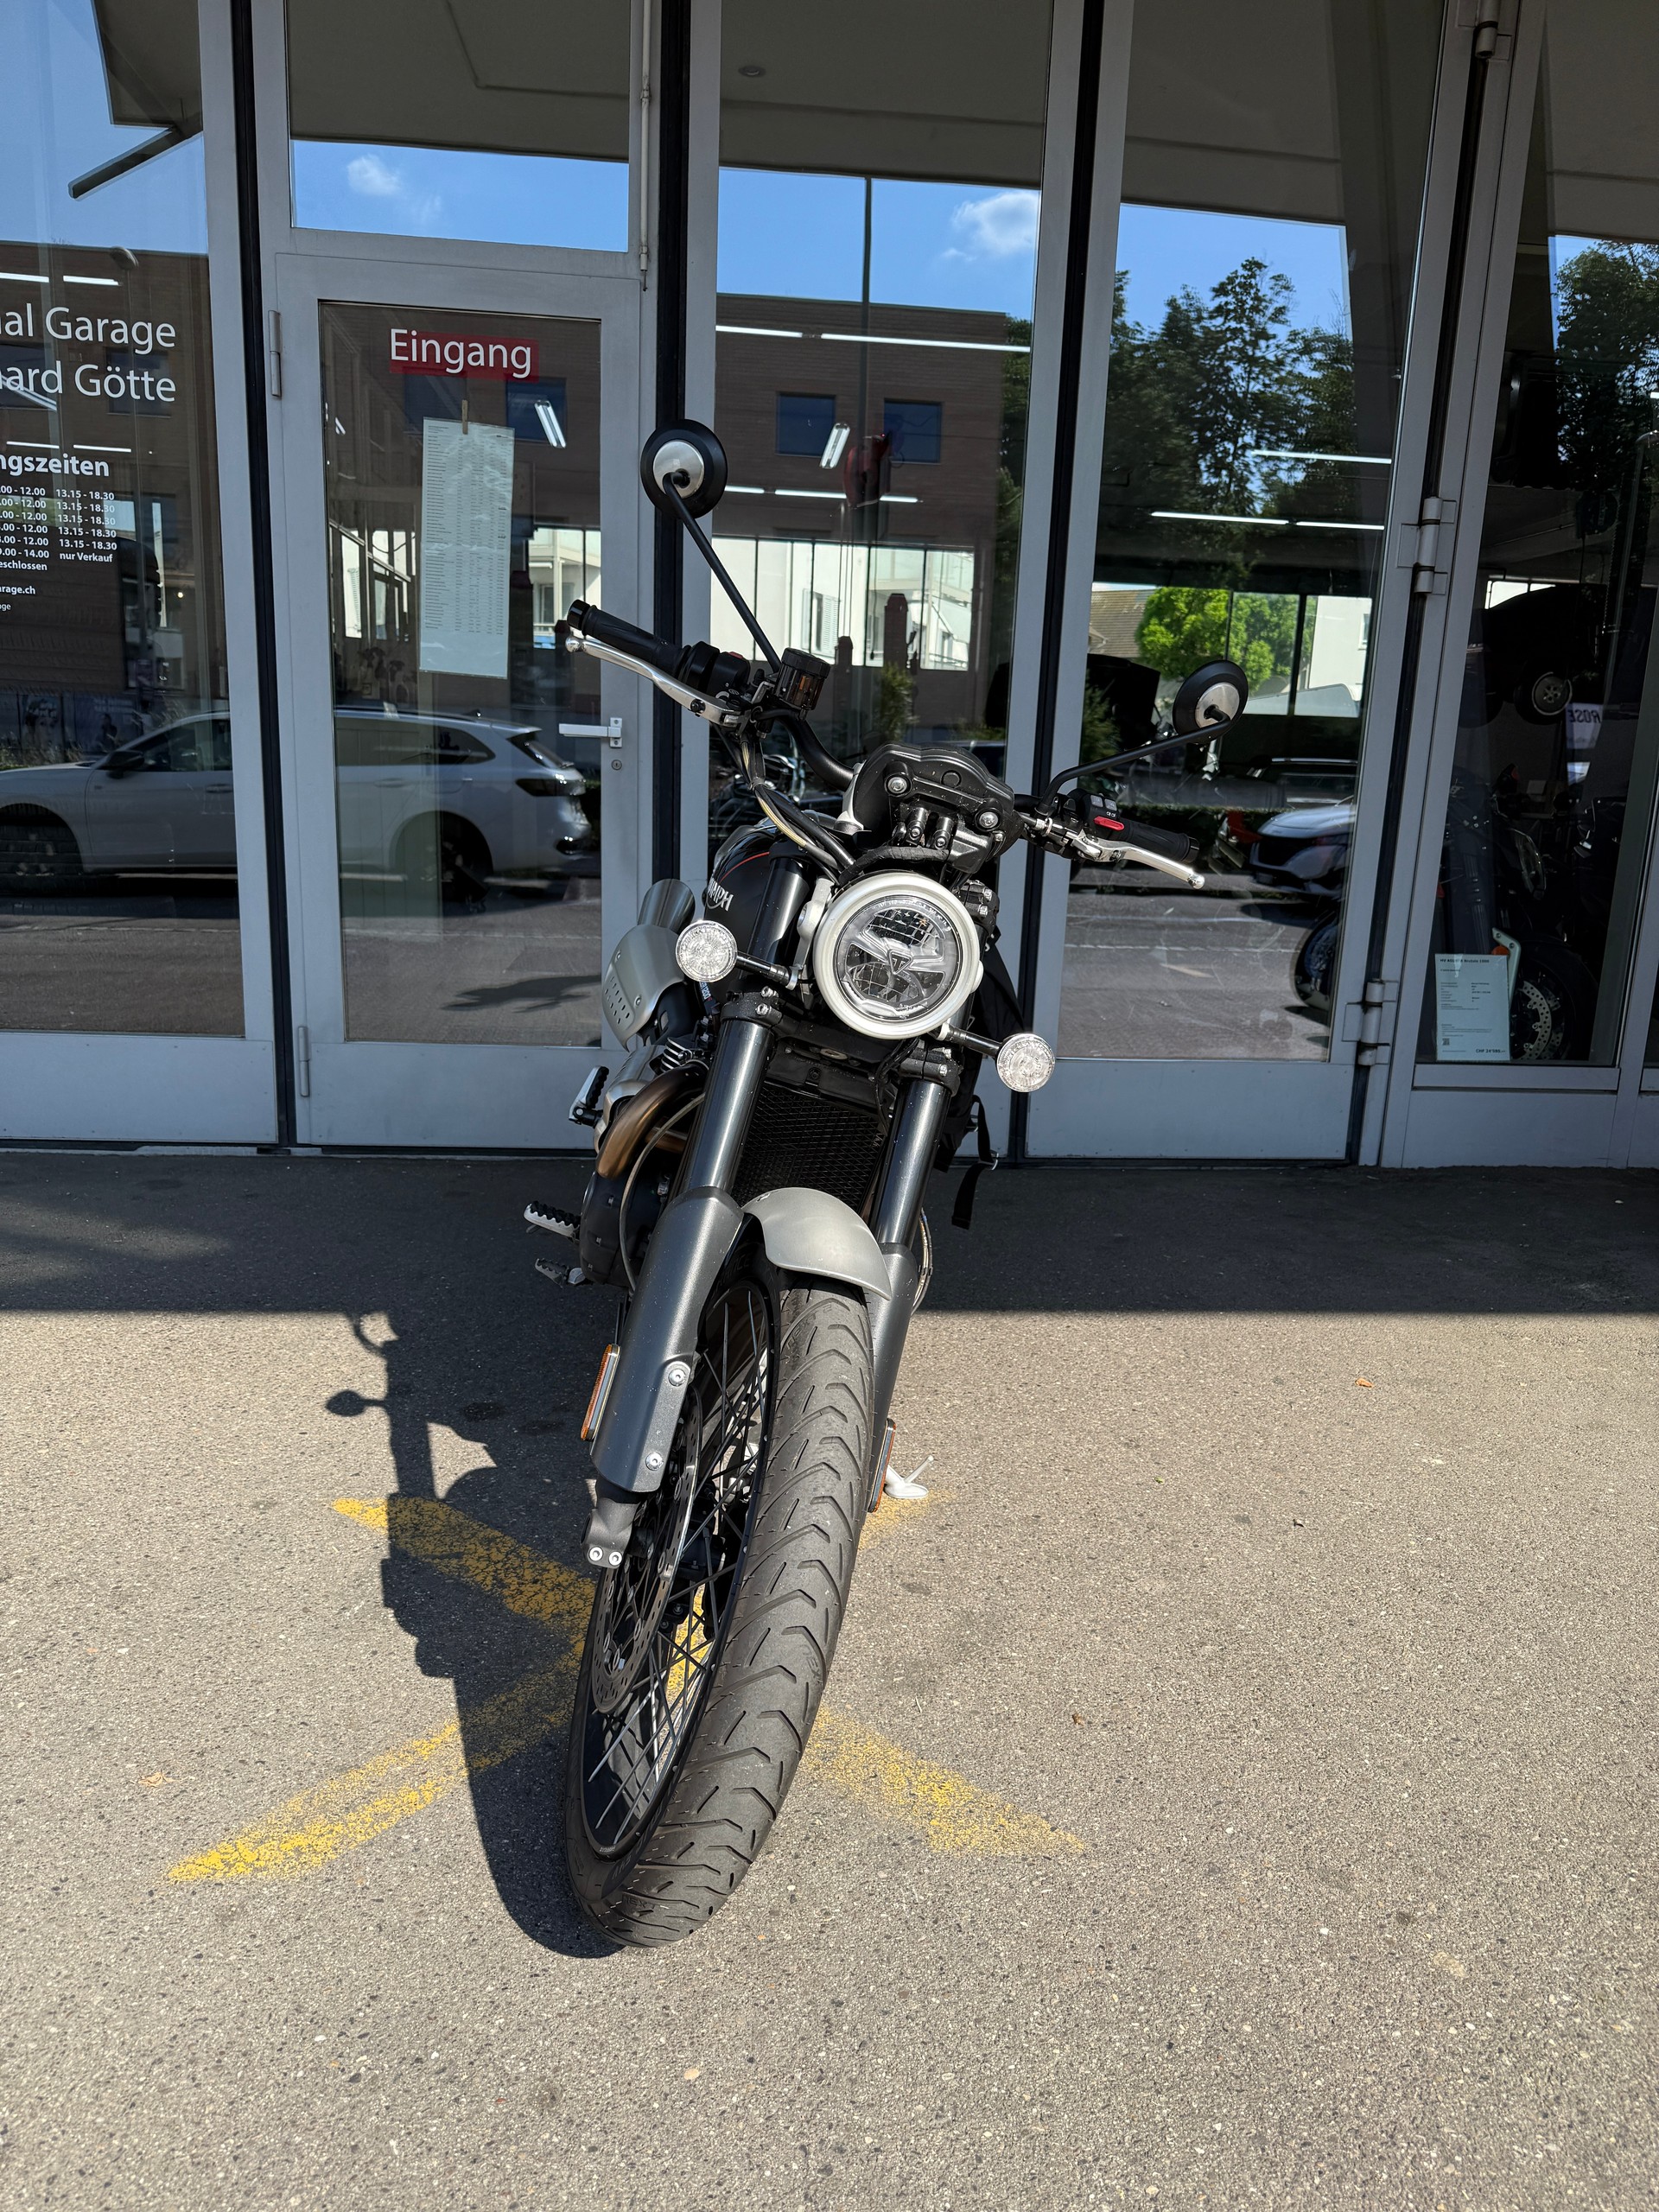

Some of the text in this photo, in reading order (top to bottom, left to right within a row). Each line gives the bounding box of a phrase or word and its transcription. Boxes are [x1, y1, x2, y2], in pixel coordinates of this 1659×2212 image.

[0, 303, 176, 355] al Garage
[391, 328, 532, 379] Eingang
[0, 360, 176, 402] ard Götte
[20, 486, 46, 496] 12.00
[55, 488, 81, 499] 13.15
[89, 491, 115, 501] 18.30
[21, 499, 47, 509] 12.00
[57, 501, 82, 511] 13.15
[90, 504, 115, 513] 18.30
[22, 512, 48, 521] 12.00
[58, 514, 83, 524] 13.15
[90, 516, 116, 525] 18.30
[0, 523, 15, 531] .00
[22, 524, 48, 534] 12.00
[58, 526, 84, 537] 13.15
[92, 529, 117, 538] 18.30
[0, 536, 16, 544] .00
[23, 537, 49, 546] 12.00
[60, 539, 84, 549] 13.15
[92, 541, 118, 550] 18.30
[24, 549, 49, 559] 14.00
[60, 552, 75, 561] nur
[77, 552, 113, 563] Verkauf
[0, 585, 35, 595] rage.ch
[0, 603, 11, 612] ge
